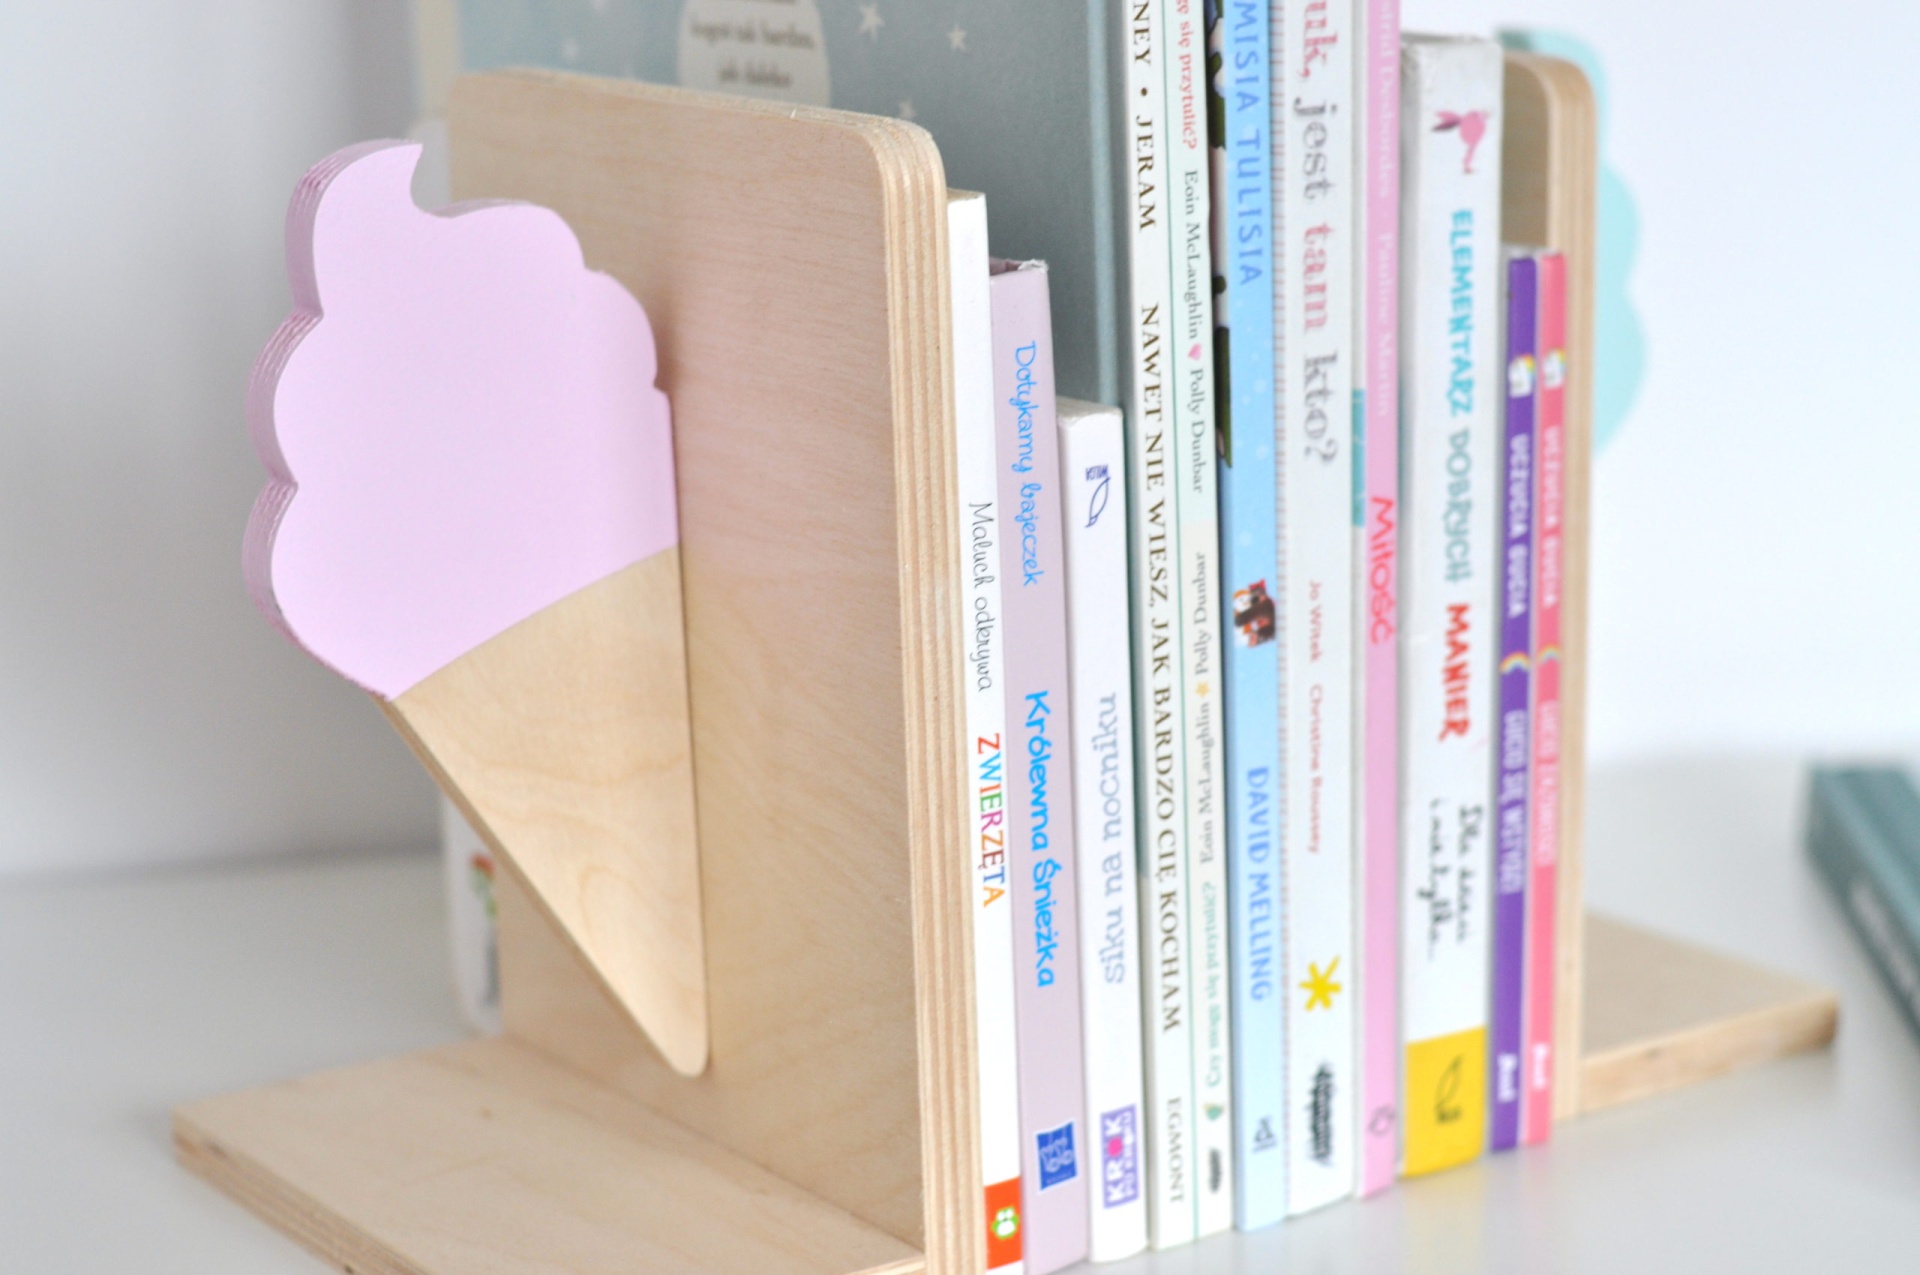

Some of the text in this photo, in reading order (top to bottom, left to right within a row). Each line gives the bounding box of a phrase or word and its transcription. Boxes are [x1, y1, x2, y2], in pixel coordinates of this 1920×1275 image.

[1133, 2, 1157, 231] NEY JERAM
[1178, 20, 1195, 49] się
[1178, 53, 1198, 150] przytulić?
[1233, 2, 1263, 286] MISIA TULISIA
[1293, 97, 1338, 201] jest
[1184, 169, 1204, 341] Eoin McLaughlin
[1303, 224, 1334, 331] tam
[1009, 340, 1045, 587] Dotykamy bajeczek
[1187, 368, 1208, 494] Polly Dunbar
[1303, 348, 1338, 466] kto?
[1438, 208, 1475, 743] ELEMENTARZ DOBRYCH MANIER
[968, 503, 1006, 908] Maluch odkrywa ZWIERZĘTA
[1141, 302, 1181, 1033] NAWET NIE WIESZ, JAK BARDZO CIĘ KOCHAM
[1191, 552, 1211, 677] Polly Dunbar
[1025, 690, 1062, 988] Królewna Śnieżka
[1092, 692, 1125, 985] siku na nocniku
[1246, 767, 1274, 1002] DAVID MELLING
[1167, 1096, 1184, 1203] EGMONT
